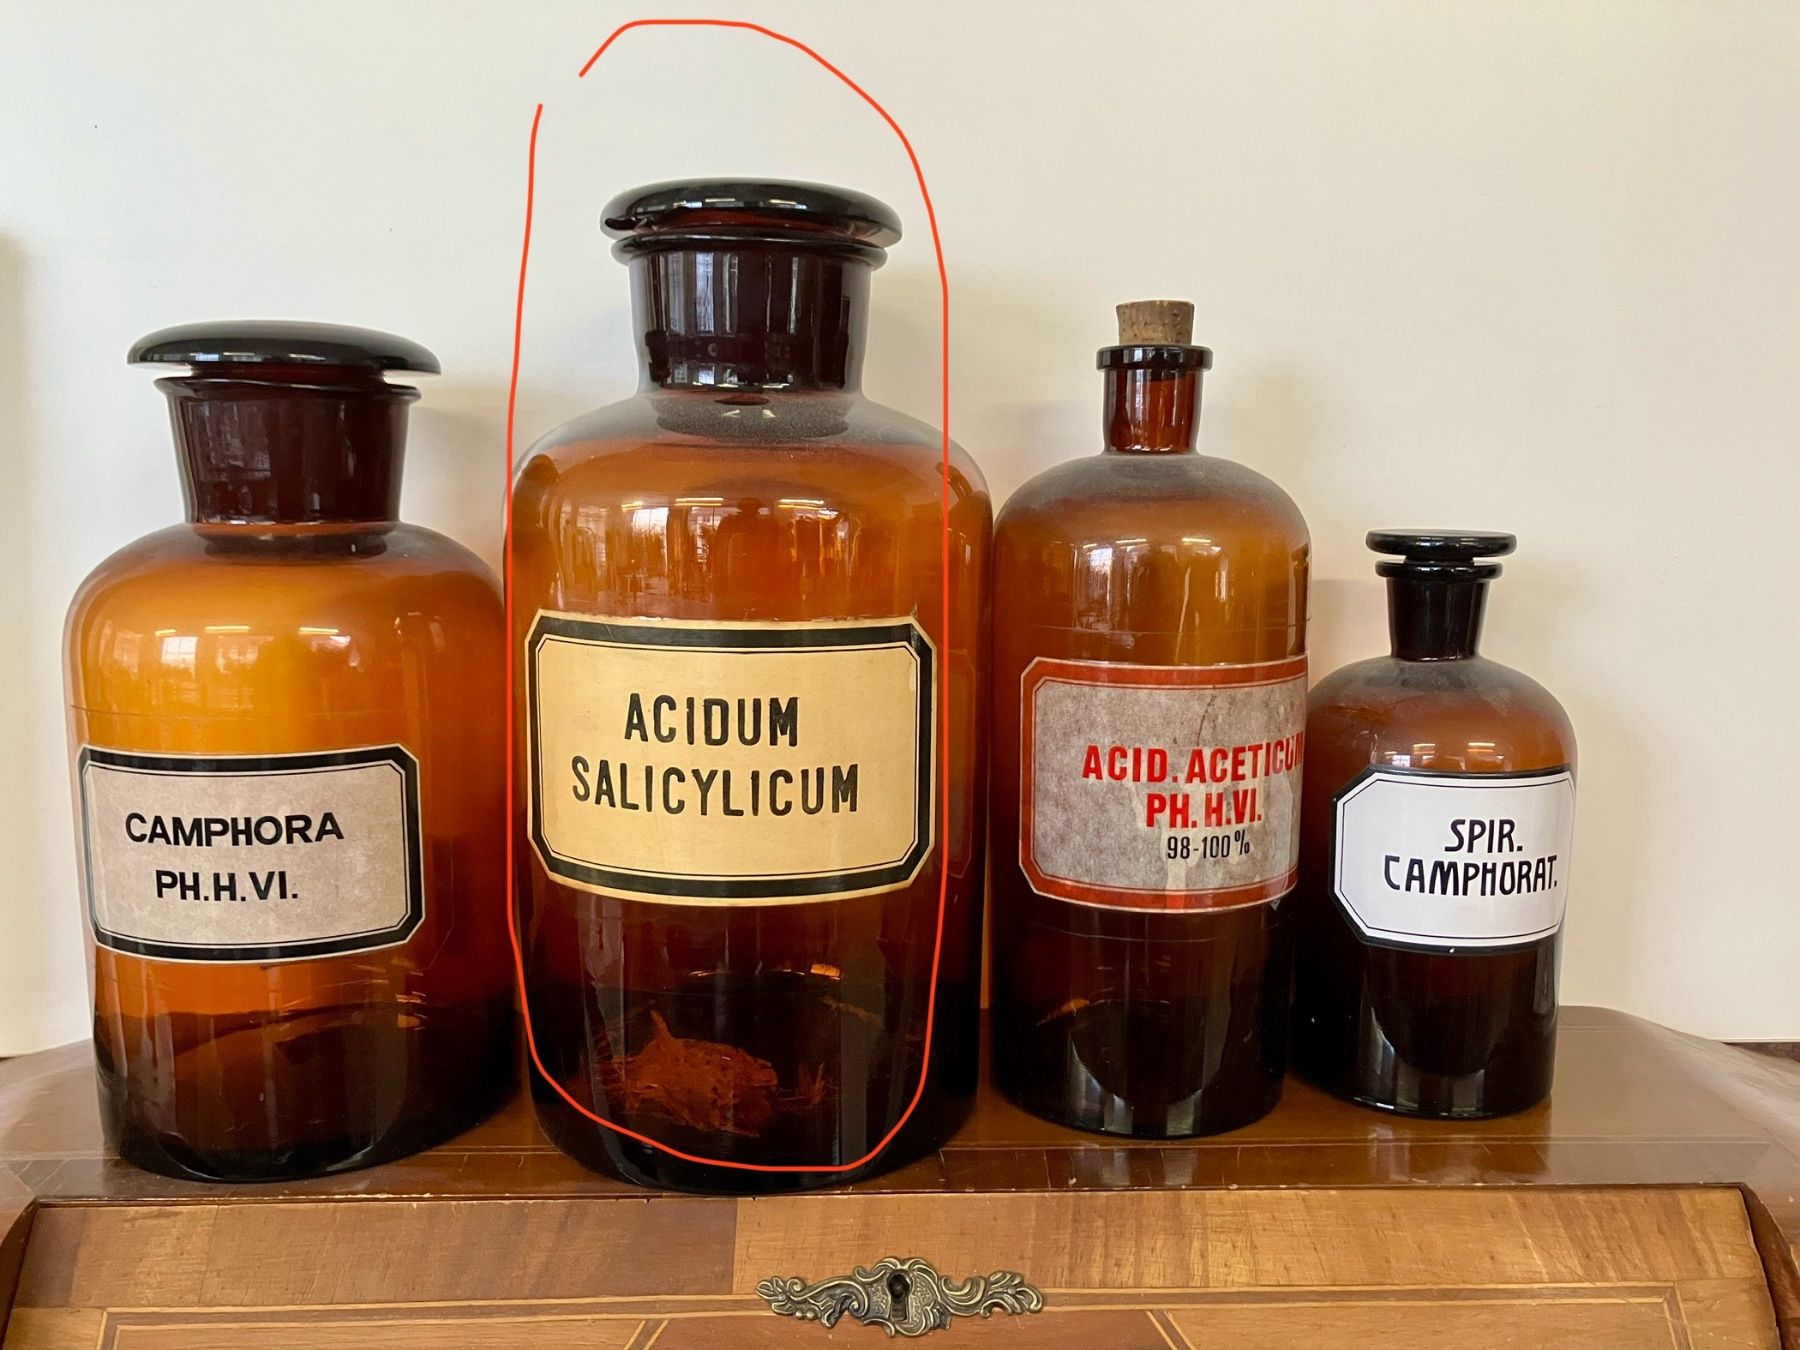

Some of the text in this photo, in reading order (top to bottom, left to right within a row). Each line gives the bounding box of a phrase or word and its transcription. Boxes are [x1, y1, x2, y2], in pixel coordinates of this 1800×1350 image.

[624, 693, 799, 746] ACIDUM
[1082, 744, 1178, 783] ACID.
[571, 756, 859, 816] SALICYLICUM
[125, 812, 344, 847] CAMPHORA
[1444, 819, 1523, 853] SPIR.
[155, 869, 298, 902] PH.H.VI.
[1384, 855, 1558, 896] CAMPHORAT.
